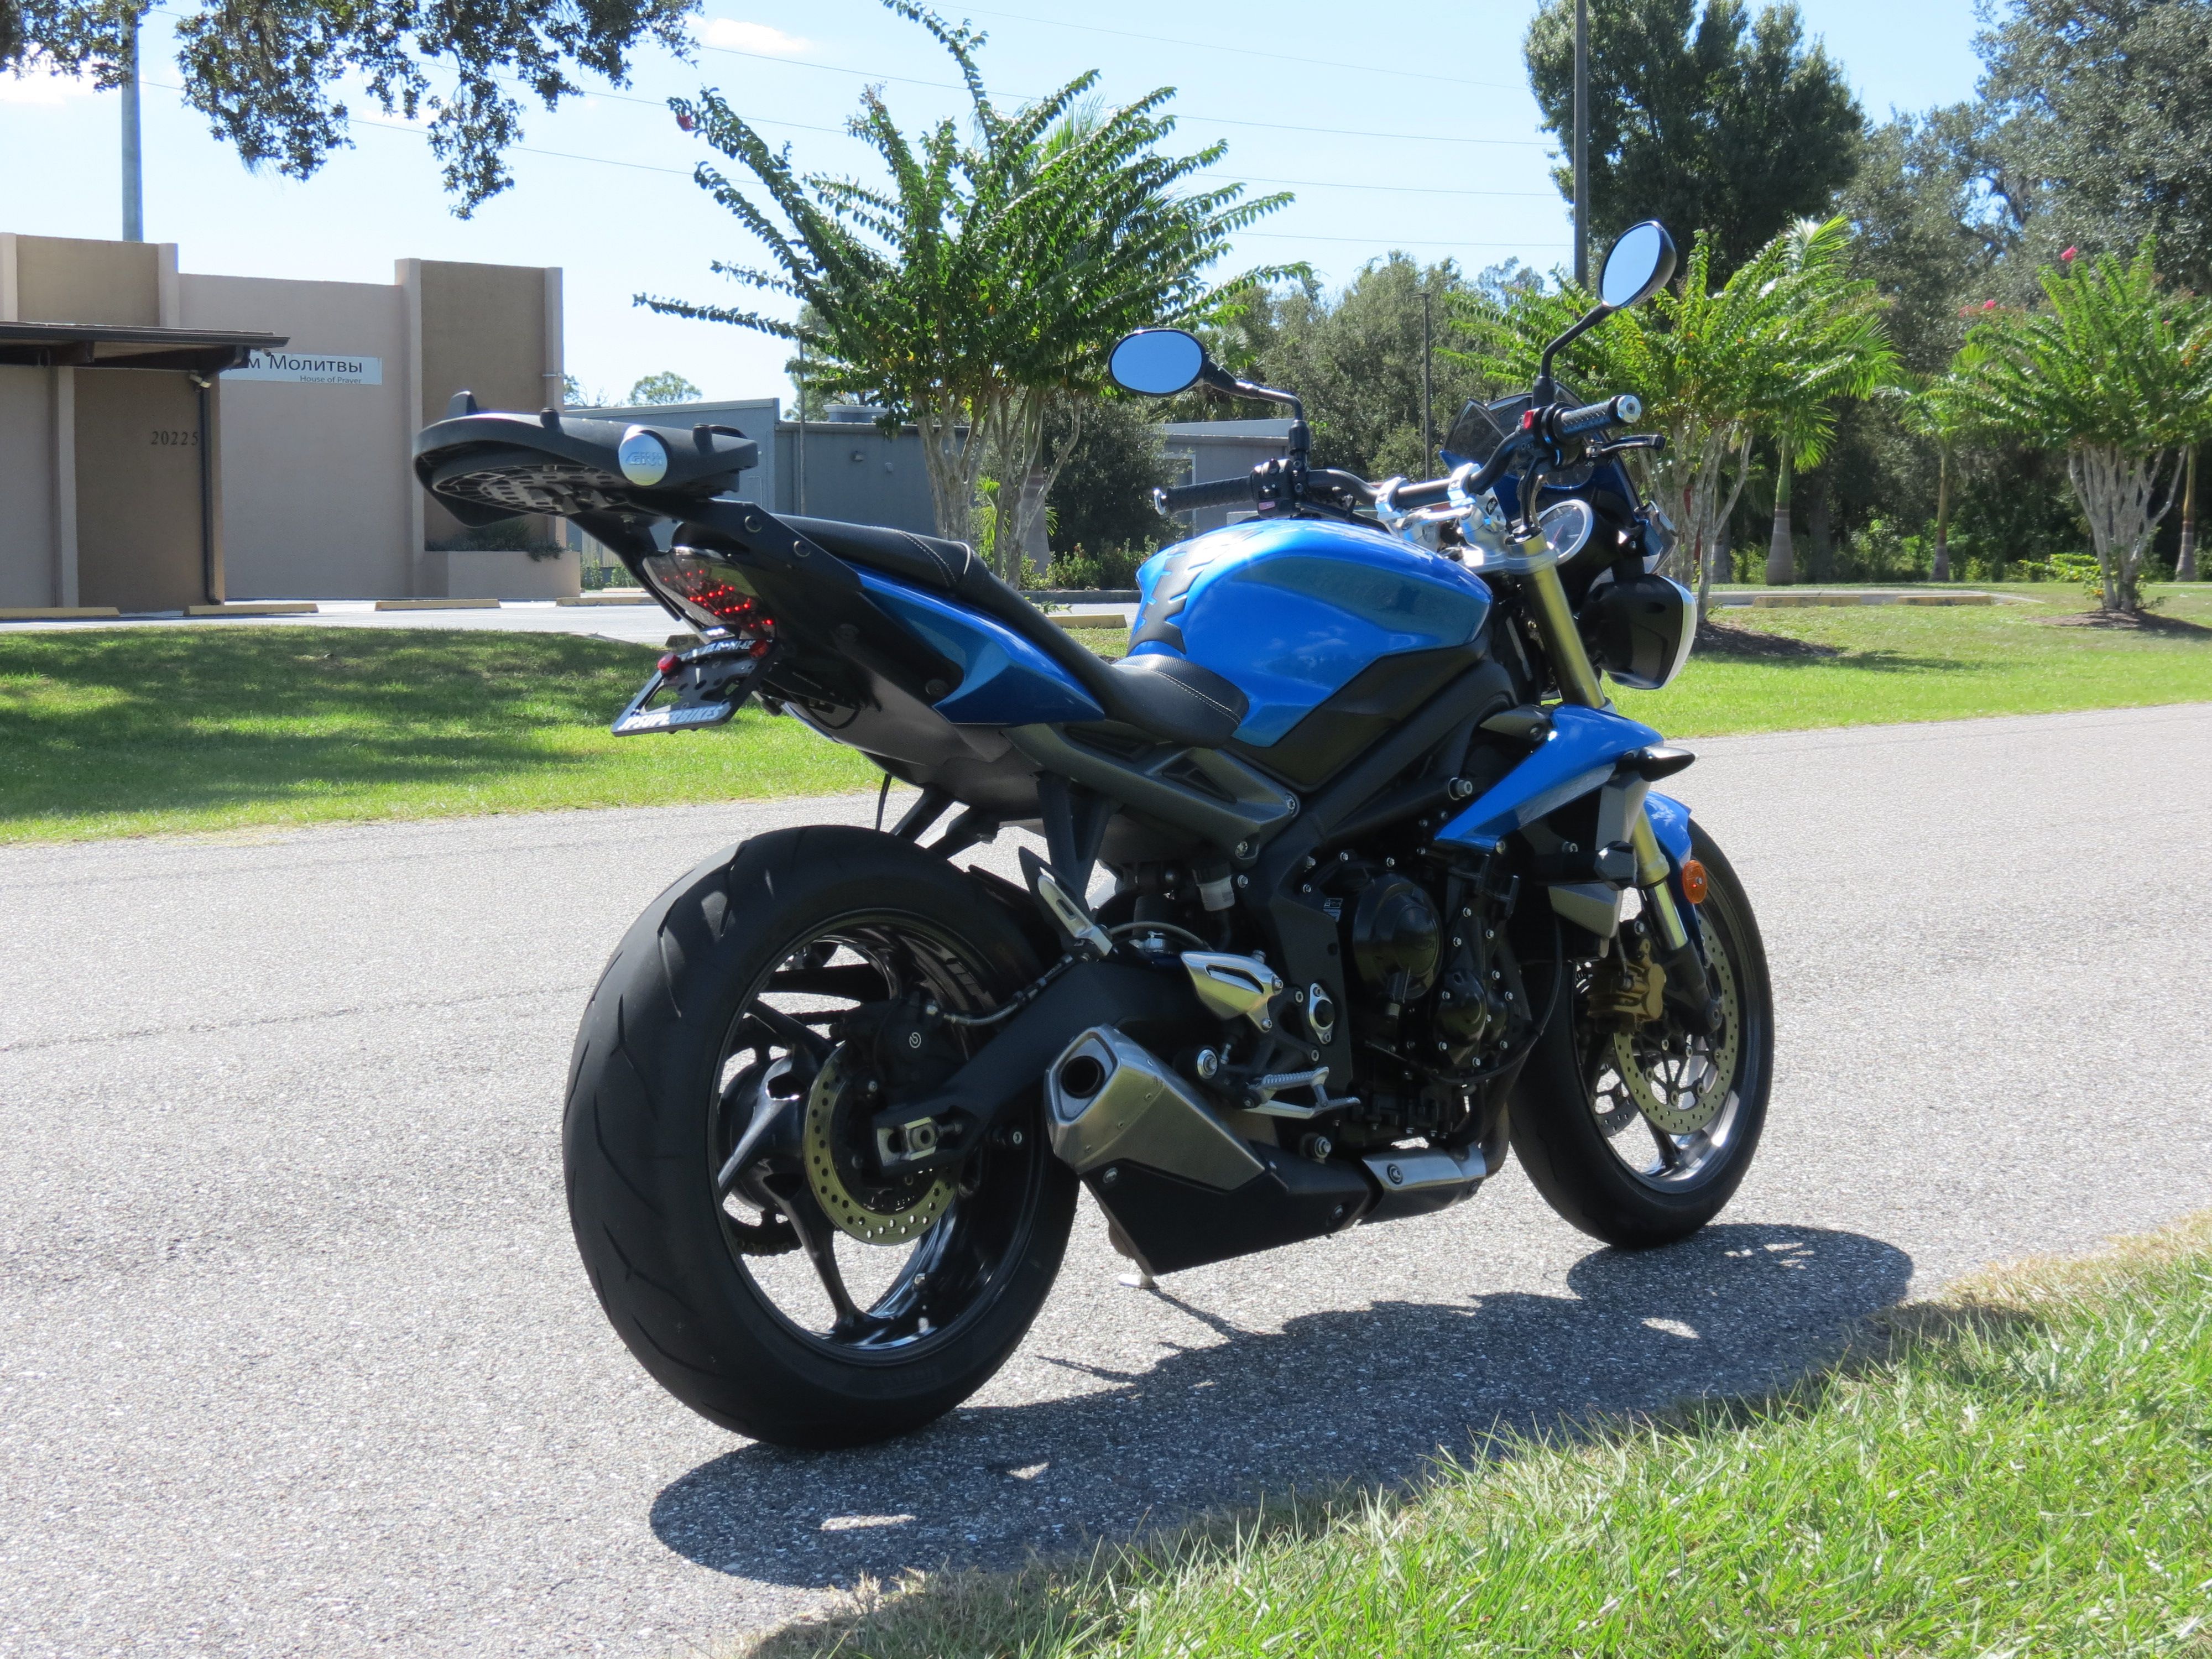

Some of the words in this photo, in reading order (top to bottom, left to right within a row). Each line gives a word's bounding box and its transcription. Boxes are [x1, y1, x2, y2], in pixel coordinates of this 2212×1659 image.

[269, 354, 362, 373] Молитвы
[151, 431, 198, 445] 20225
[625, 451, 664, 466] GIVI
[617, 706, 723, 731] JPSUPERBIKES
